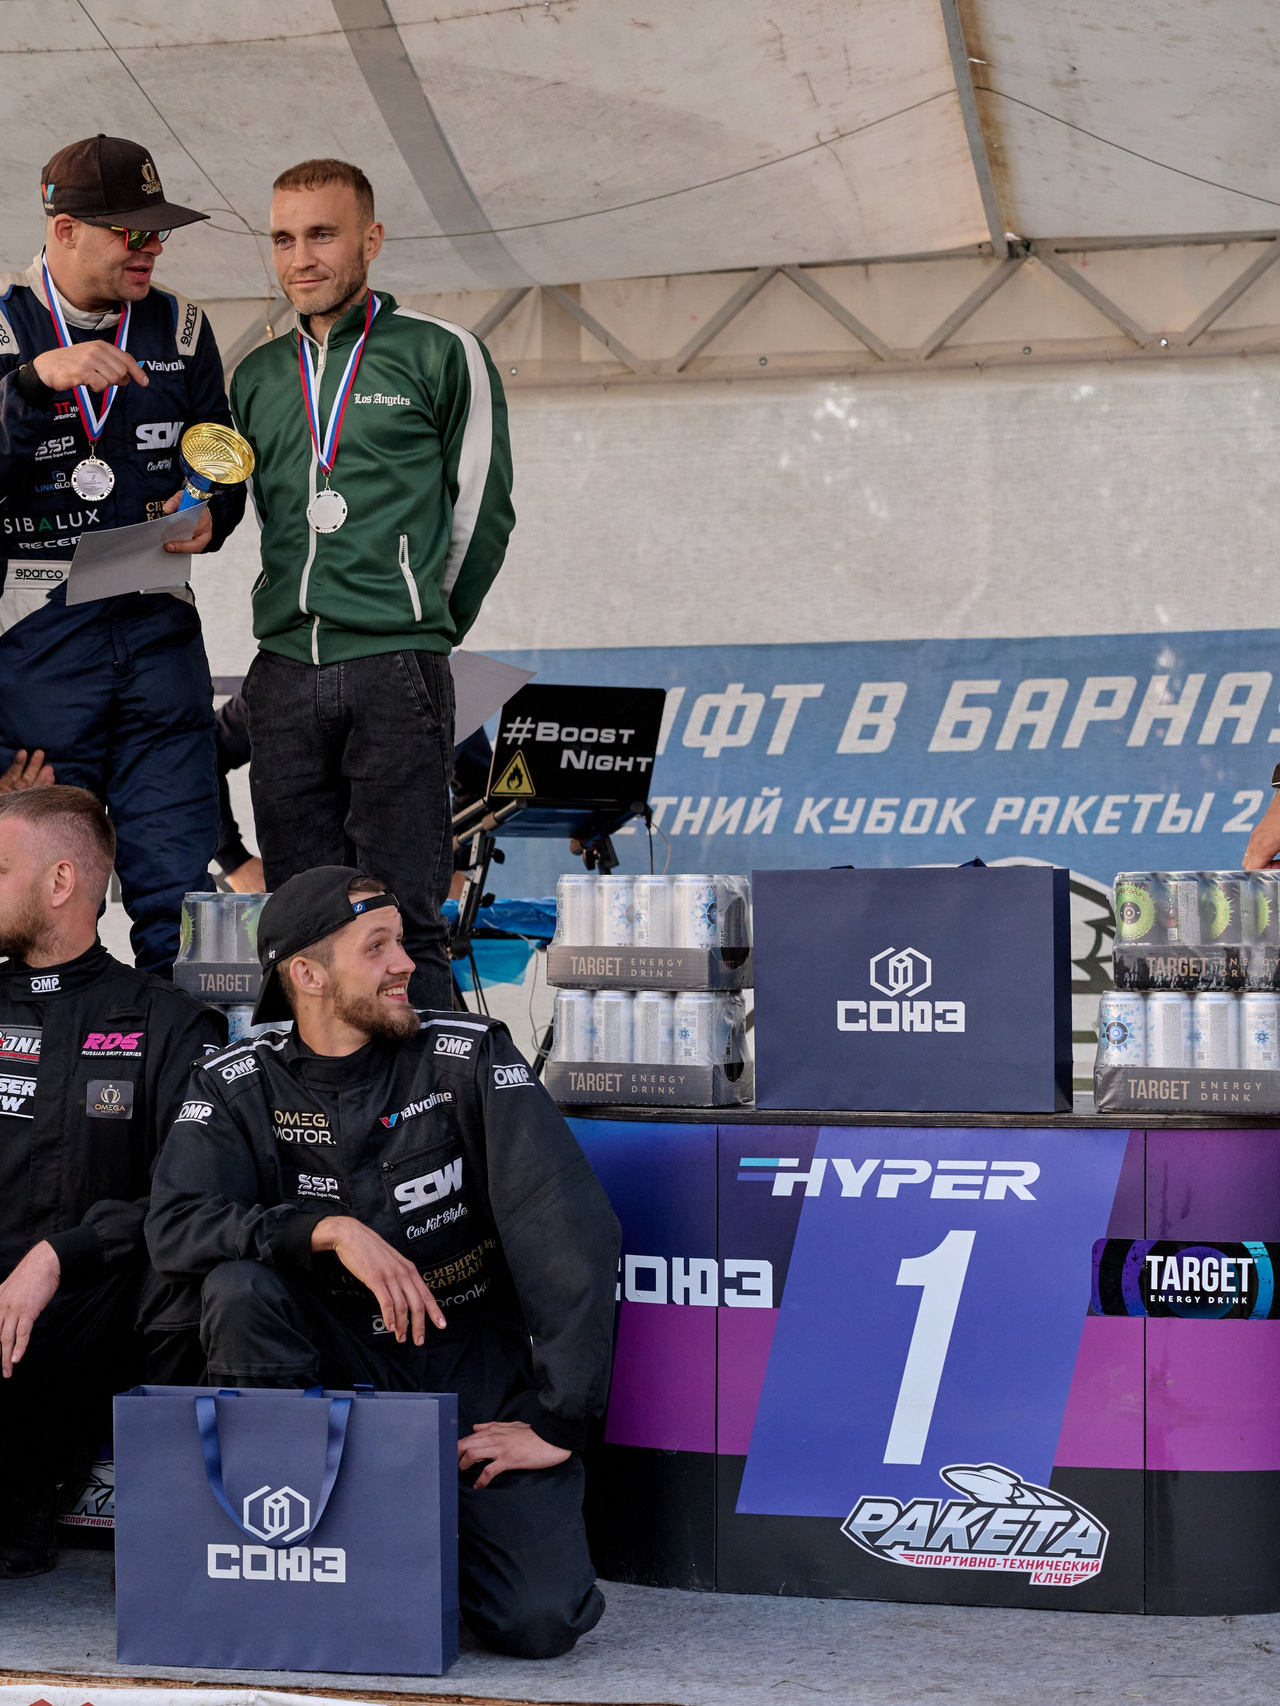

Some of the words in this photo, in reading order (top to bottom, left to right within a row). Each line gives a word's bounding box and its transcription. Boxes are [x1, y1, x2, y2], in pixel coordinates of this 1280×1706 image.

[180, 303, 198, 347] sparco
[354, 393, 372, 404] Los
[372, 393, 411, 406] Angeles
[3, 508, 101, 534] SIBALUX
[15, 567, 64, 580] sparco
[835, 681, 908, 755] В
[793, 797, 977, 836] КУБОК
[984, 792, 1215, 836] РАКЕТЫ
[570, 957, 623, 977] TARGET
[630, 957, 683, 968] ENERGY
[630, 968, 674, 978] DRINK
[1146, 956, 1209, 977] TARGET
[1220, 957, 1280, 966] ENERGY
[31, 977, 61, 992] OMP
[198, 973, 251, 992] TARGET
[837, 1000, 966, 1032] СОЮЗ
[82, 1032, 144, 1050] RDS
[435, 1037, 473, 1056] OMP
[221, 1058, 256, 1081] OMP
[493, 1066, 531, 1085] OMP
[568, 1072, 622, 1093] TARGET
[631, 1074, 686, 1084] ENERGY
[631, 1085, 676, 1095] DRINK
[1128, 1079, 1190, 1101] TARGET
[1200, 1081, 1263, 1091] ENERGY
[94, 1103, 126, 1111] OMEGA
[1200, 1092, 1251, 1102] DRINK
[178, 1104, 212, 1121] OMP
[298, 1174, 339, 1193] SSP
[393, 1156, 463, 1215] SCW
[737, 1157, 1041, 1201] HYPER
[614, 1254, 774, 1309] ОЮЗ
[1146, 1255, 1253, 1292] TARGET
[1150, 1294, 1201, 1304] ENERGY
[1208, 1296, 1248, 1305] DRINK
[882, 1229, 977, 1466] 1
[846, 1498, 1105, 1557] РАКЕТА
[207, 1544, 347, 1584] СОЮЗ
[915, 1553, 1101, 1573] СПОРТИВНО-ТЕХНИЧЕСКИЙ
[1033, 1572, 1072, 1584] КЛУБ
